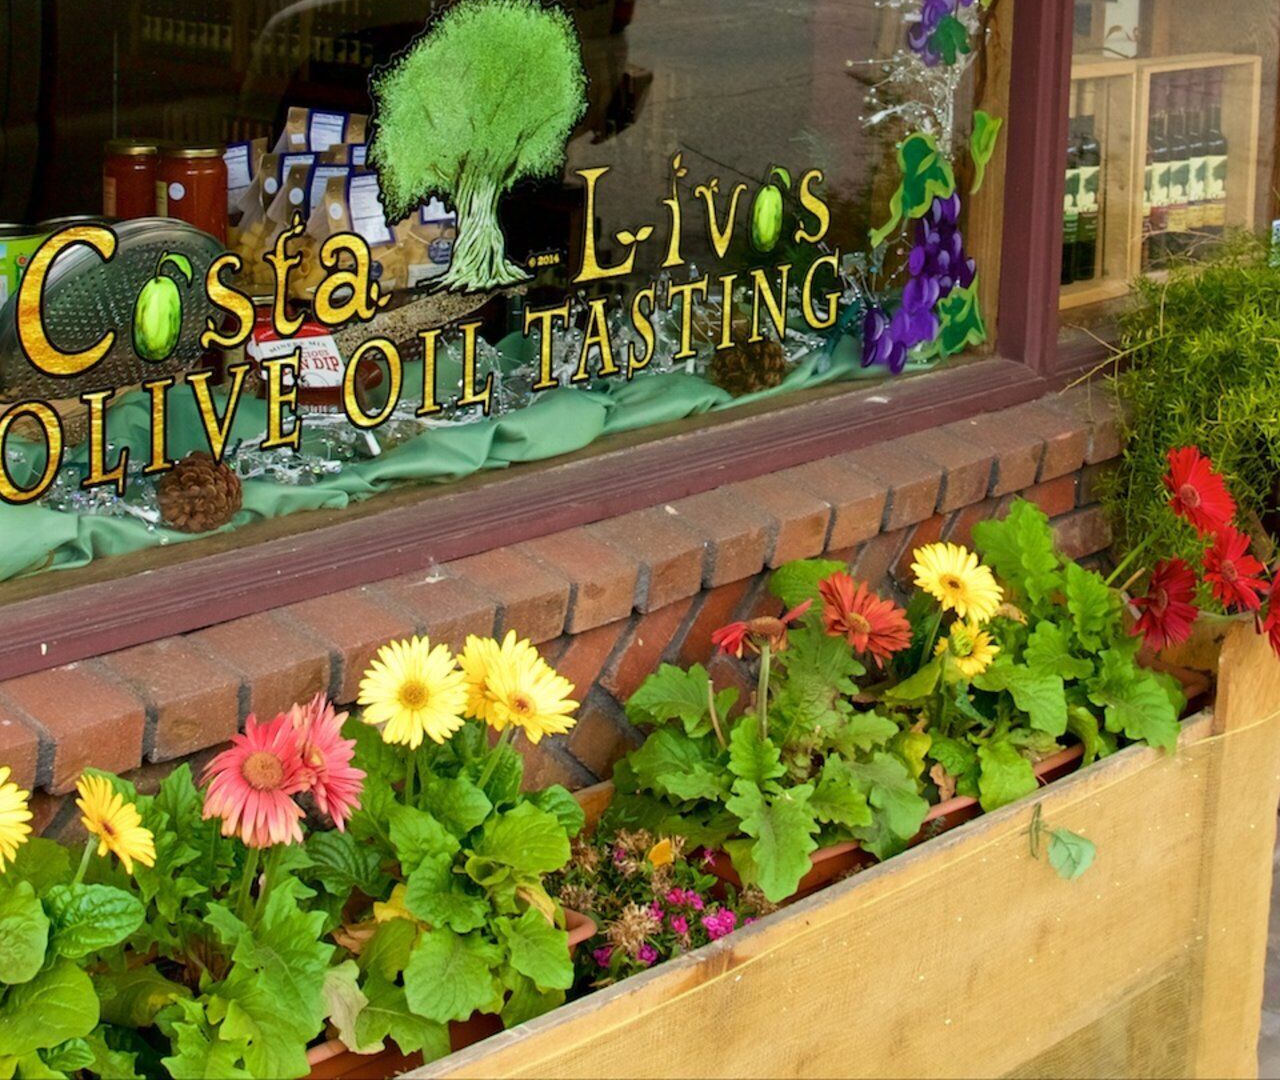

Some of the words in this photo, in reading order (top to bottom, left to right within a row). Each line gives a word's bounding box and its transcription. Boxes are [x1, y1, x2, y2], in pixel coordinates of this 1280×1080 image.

[17, 212, 388, 378] Costa
[312, 355, 340, 373] DIP
[342, 321, 493, 429] OIL
[524, 244, 842, 394] TASTING
